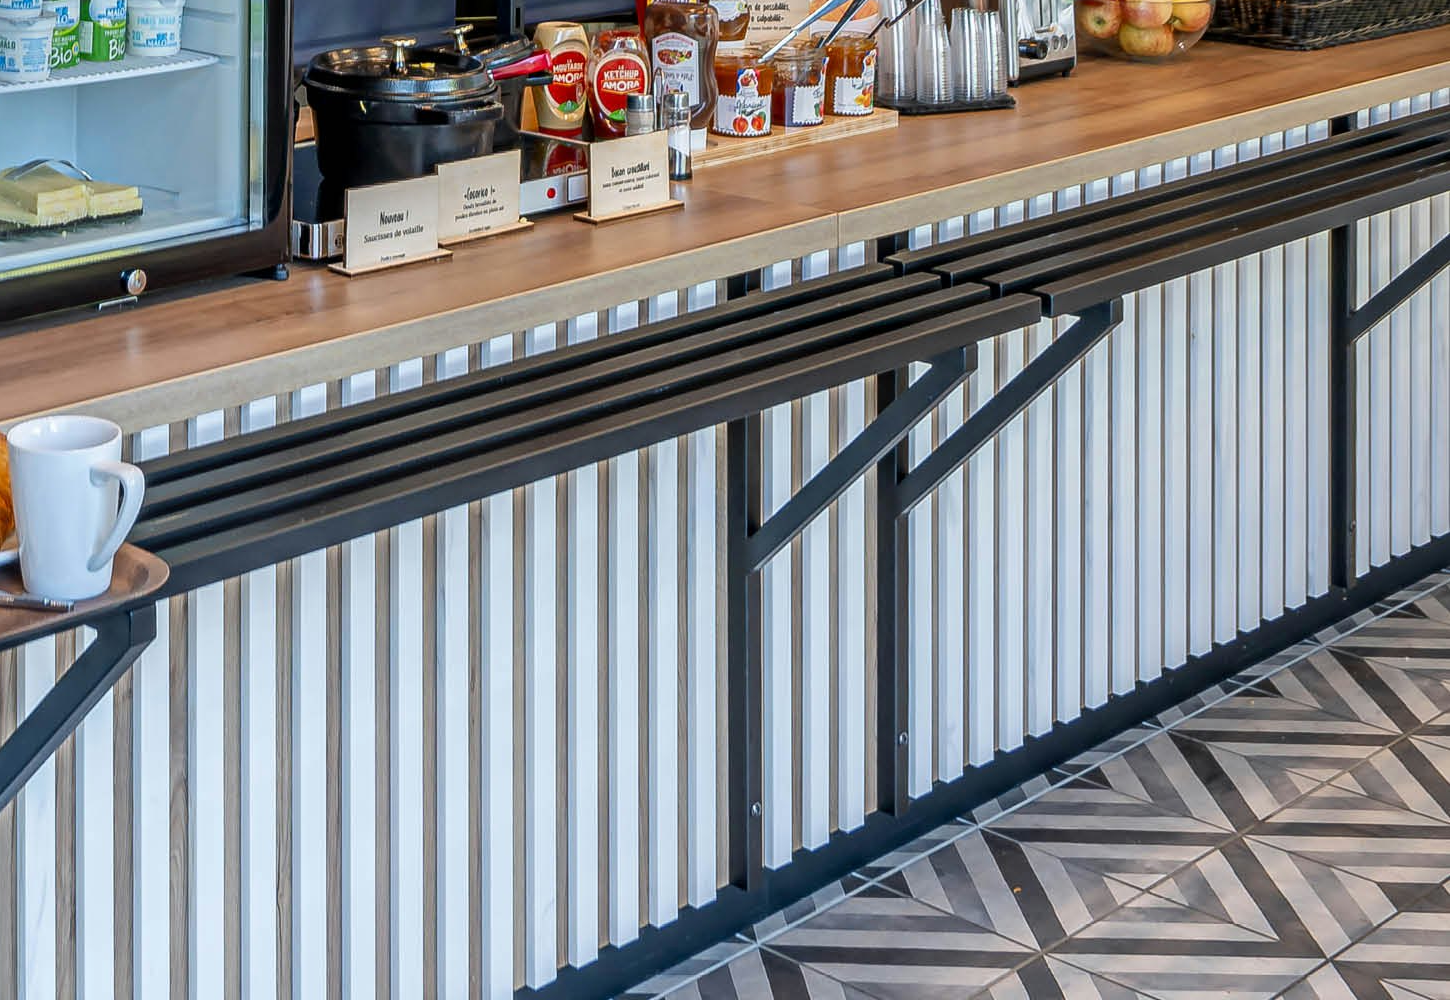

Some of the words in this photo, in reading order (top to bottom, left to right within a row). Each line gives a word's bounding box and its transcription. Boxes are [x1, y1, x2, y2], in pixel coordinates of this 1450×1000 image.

[109, 39, 126, 60] Bio
[50, 47, 72, 68] Bio
[552, 62, 584, 73] MOUTARDE
[603, 69, 640, 80] KETCHUP
[552, 72, 584, 84] AMORA
[602, 80, 640, 91] AMORA
[379, 211, 405, 227] Nouveau
[363, 231, 393, 244] Saucisses
[394, 228, 401, 237] de
[402, 224, 424, 236] volaille
